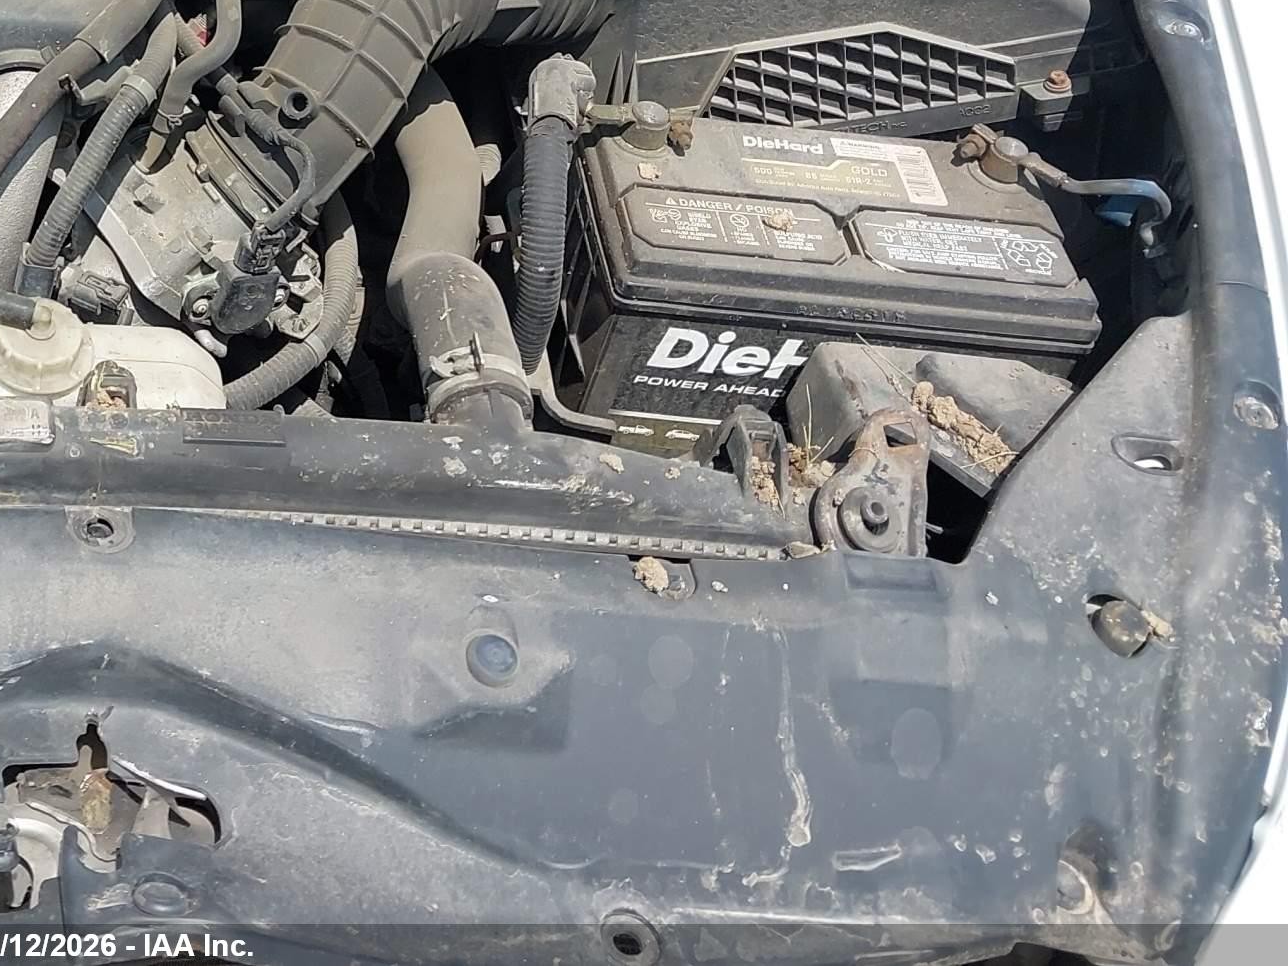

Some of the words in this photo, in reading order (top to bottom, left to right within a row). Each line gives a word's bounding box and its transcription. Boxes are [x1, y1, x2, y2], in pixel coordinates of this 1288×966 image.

[742, 135, 824, 155] DieHard
[851, 165, 888, 178] GOLD
[678, 198, 732, 211] DANGER
[633, 374, 709, 391] POWER
[713, 383, 786, 398] AHEAD
